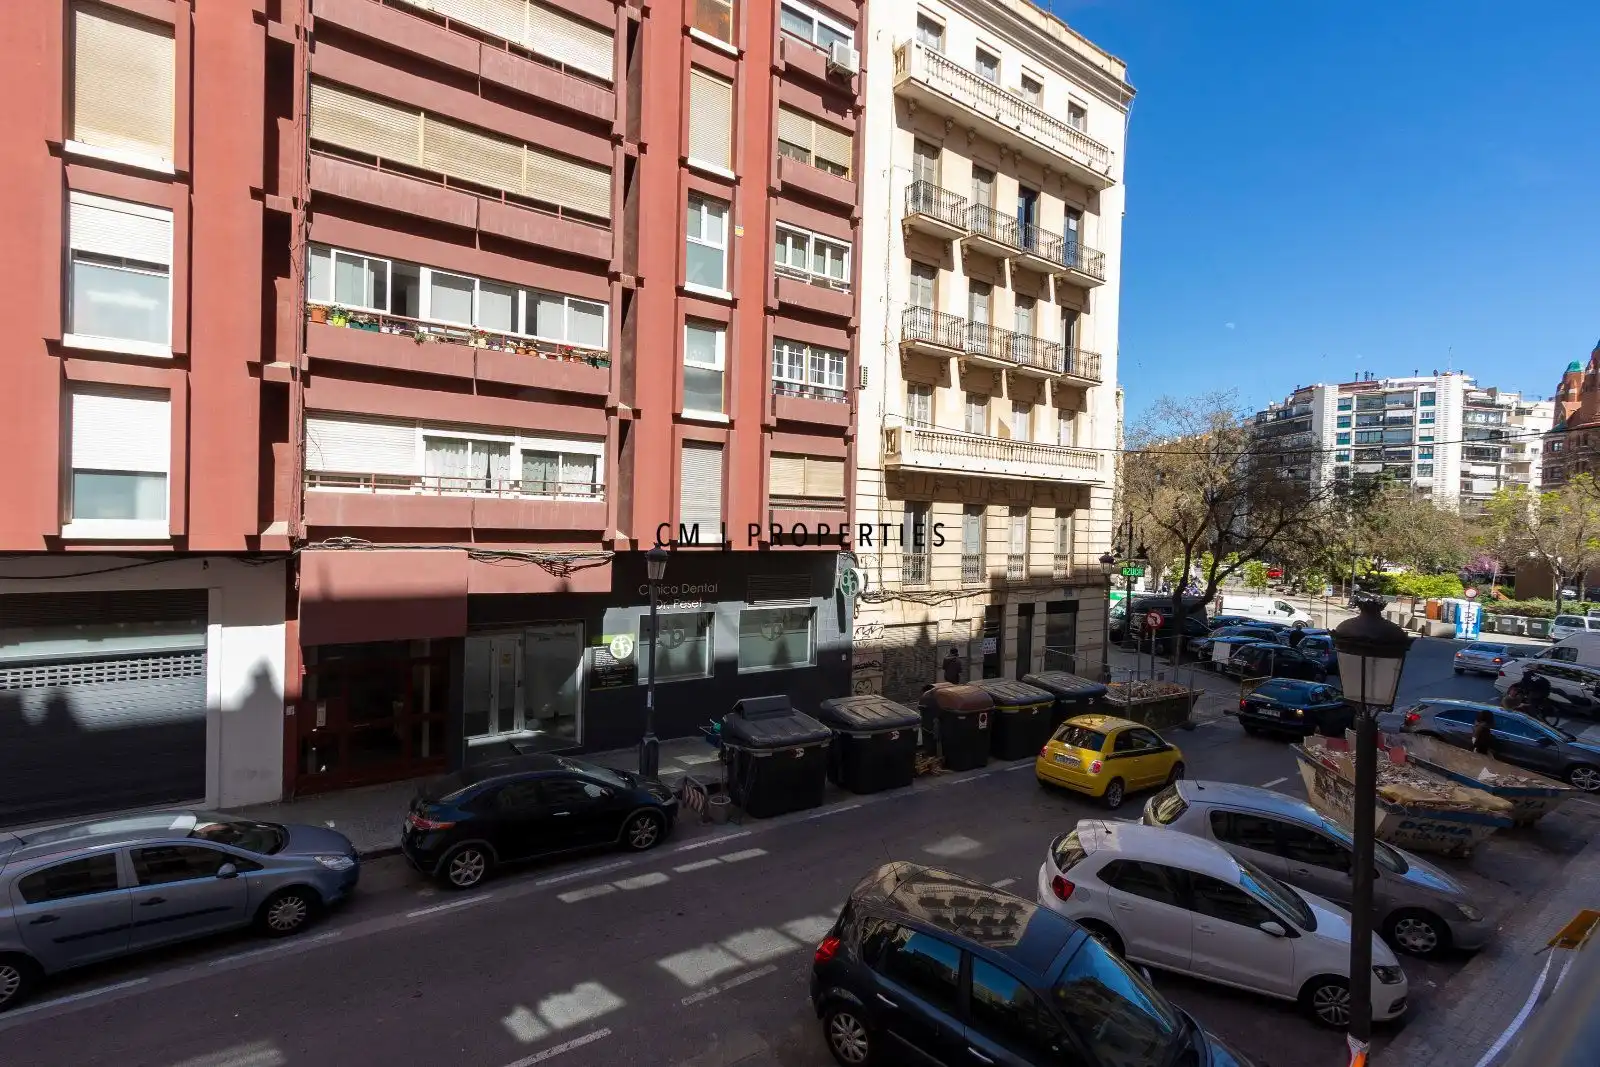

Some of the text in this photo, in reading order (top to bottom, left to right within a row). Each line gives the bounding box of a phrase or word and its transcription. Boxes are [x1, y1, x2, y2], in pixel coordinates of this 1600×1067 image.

[638, 582, 718, 596] Clnica Dental
[655, 597, 703, 610] Dr. Peset
